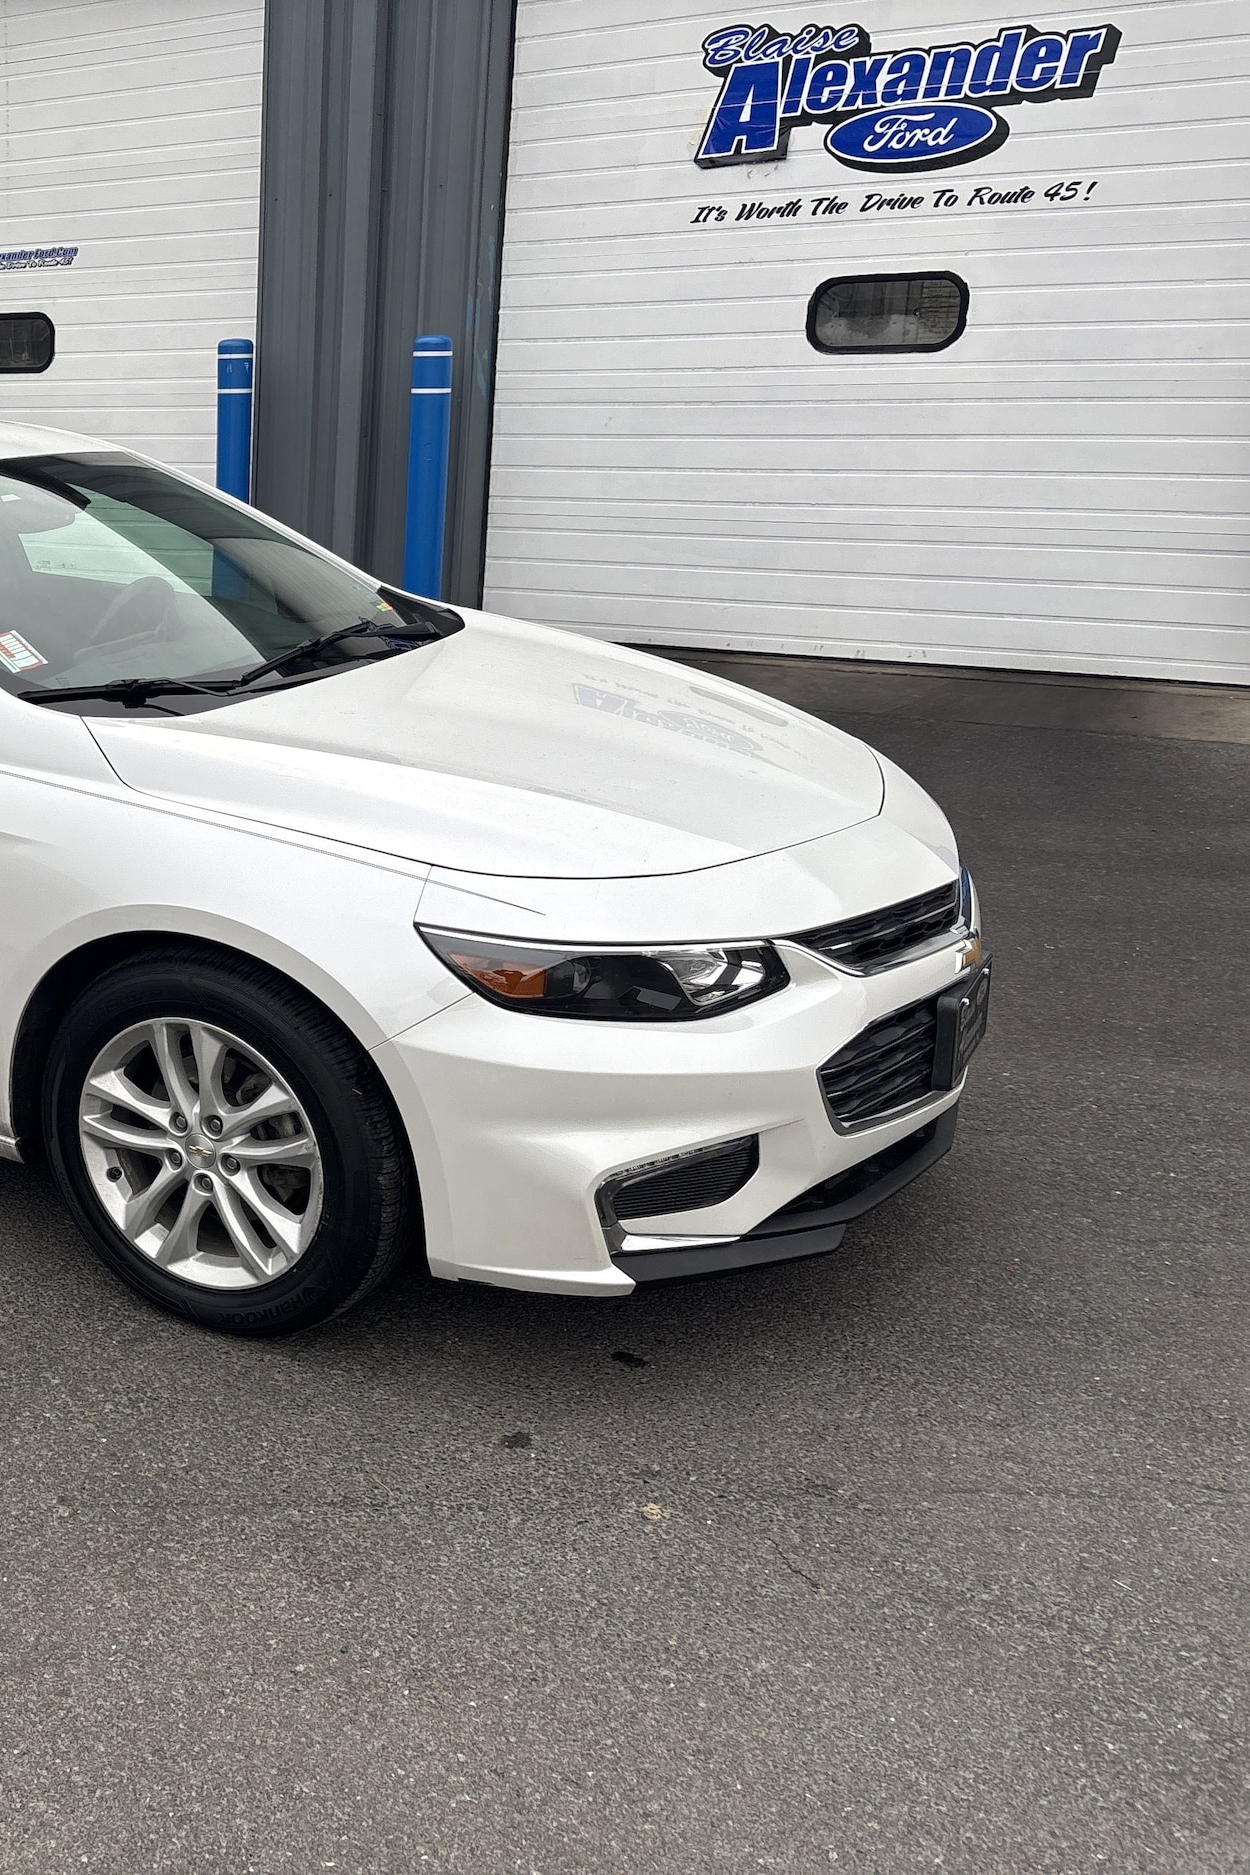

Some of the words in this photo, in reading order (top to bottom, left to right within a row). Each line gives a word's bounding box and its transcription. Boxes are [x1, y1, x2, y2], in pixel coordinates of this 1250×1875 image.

[703, 24, 862, 67] Blaise
[696, 26, 1114, 160] Alexander
[862, 113, 955, 153] Ford
[690, 205, 728, 225] It's
[735, 200, 803, 222] Worth
[810, 197, 849, 217] The
[858, 191, 924, 214] Drive
[932, 188, 958, 209] To
[966, 185, 1036, 207] Route
